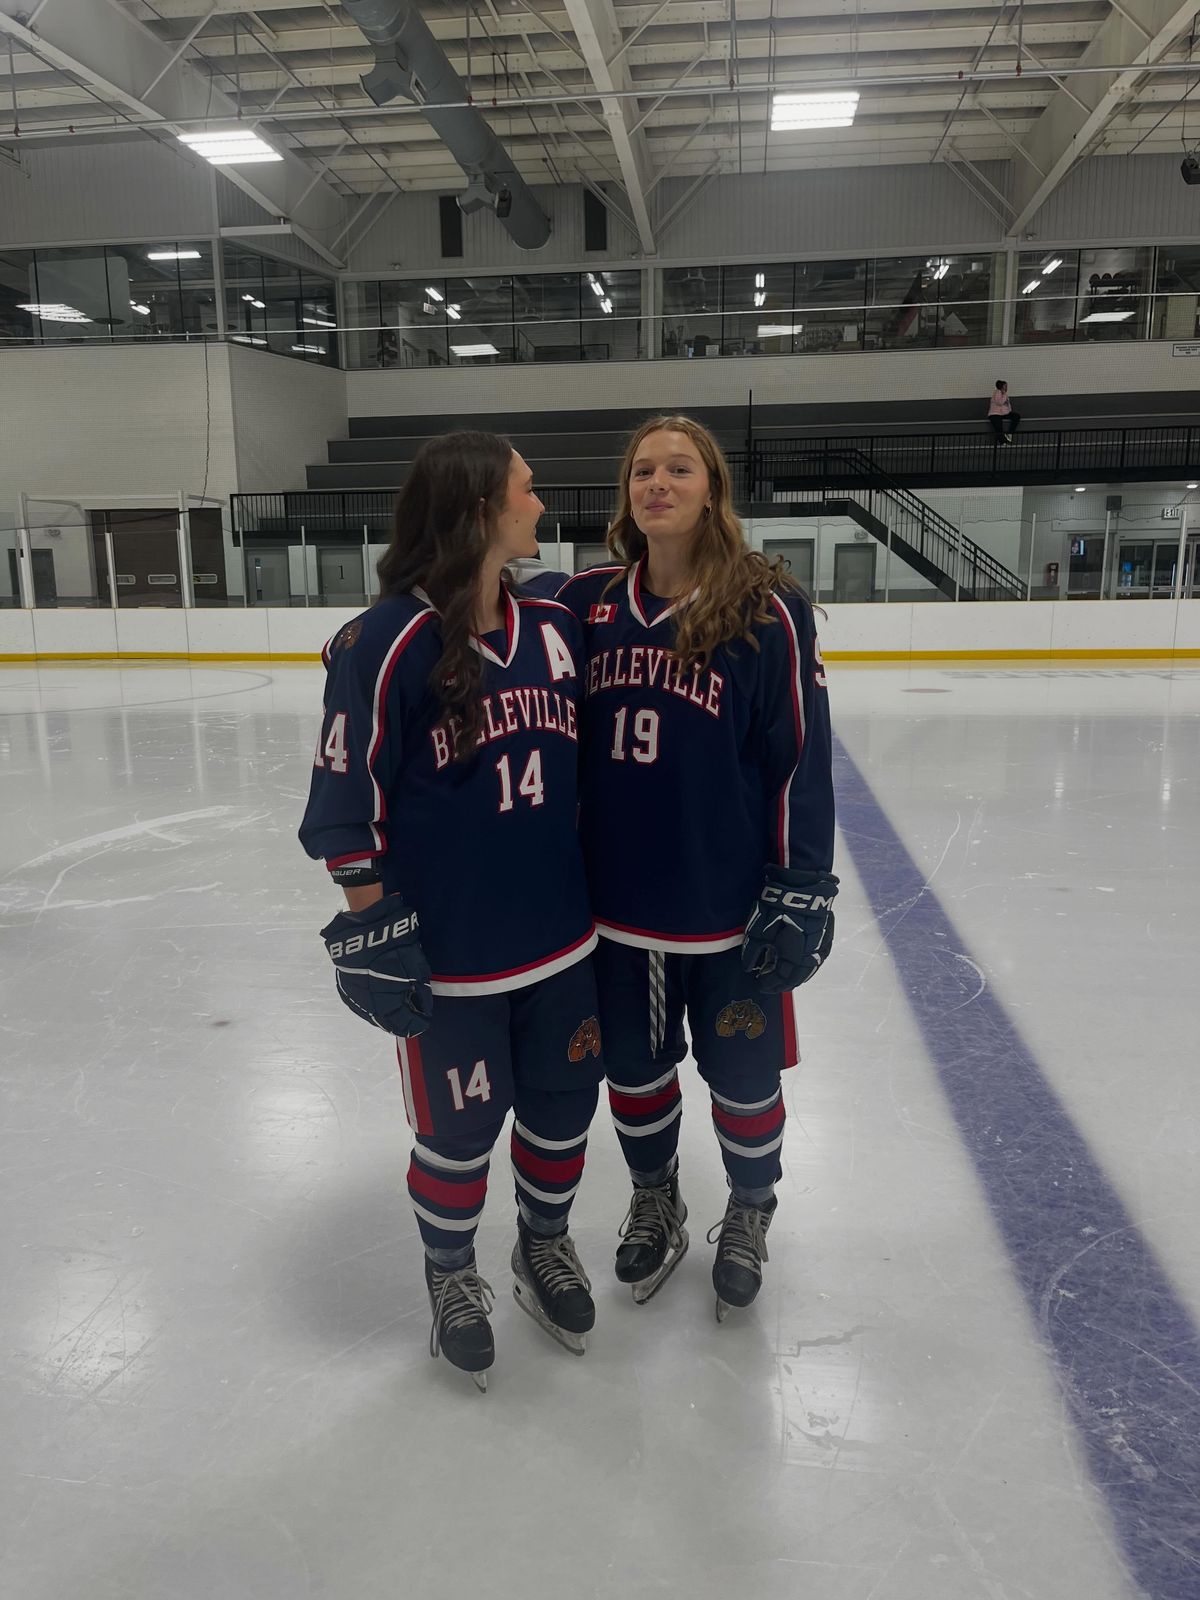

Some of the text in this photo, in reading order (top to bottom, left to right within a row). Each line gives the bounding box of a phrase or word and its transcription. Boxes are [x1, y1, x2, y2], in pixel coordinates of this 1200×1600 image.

[540, 622, 577, 682] A
[584, 647, 723, 718] ELLEVILLE
[431, 687, 578, 769] BLEVILLE
[611, 706, 660, 764] 19
[497, 749, 545, 813] 14
[760, 886, 834, 911] CCM
[329, 911, 420, 960] BAUER
[446, 1059, 491, 1111] 14
